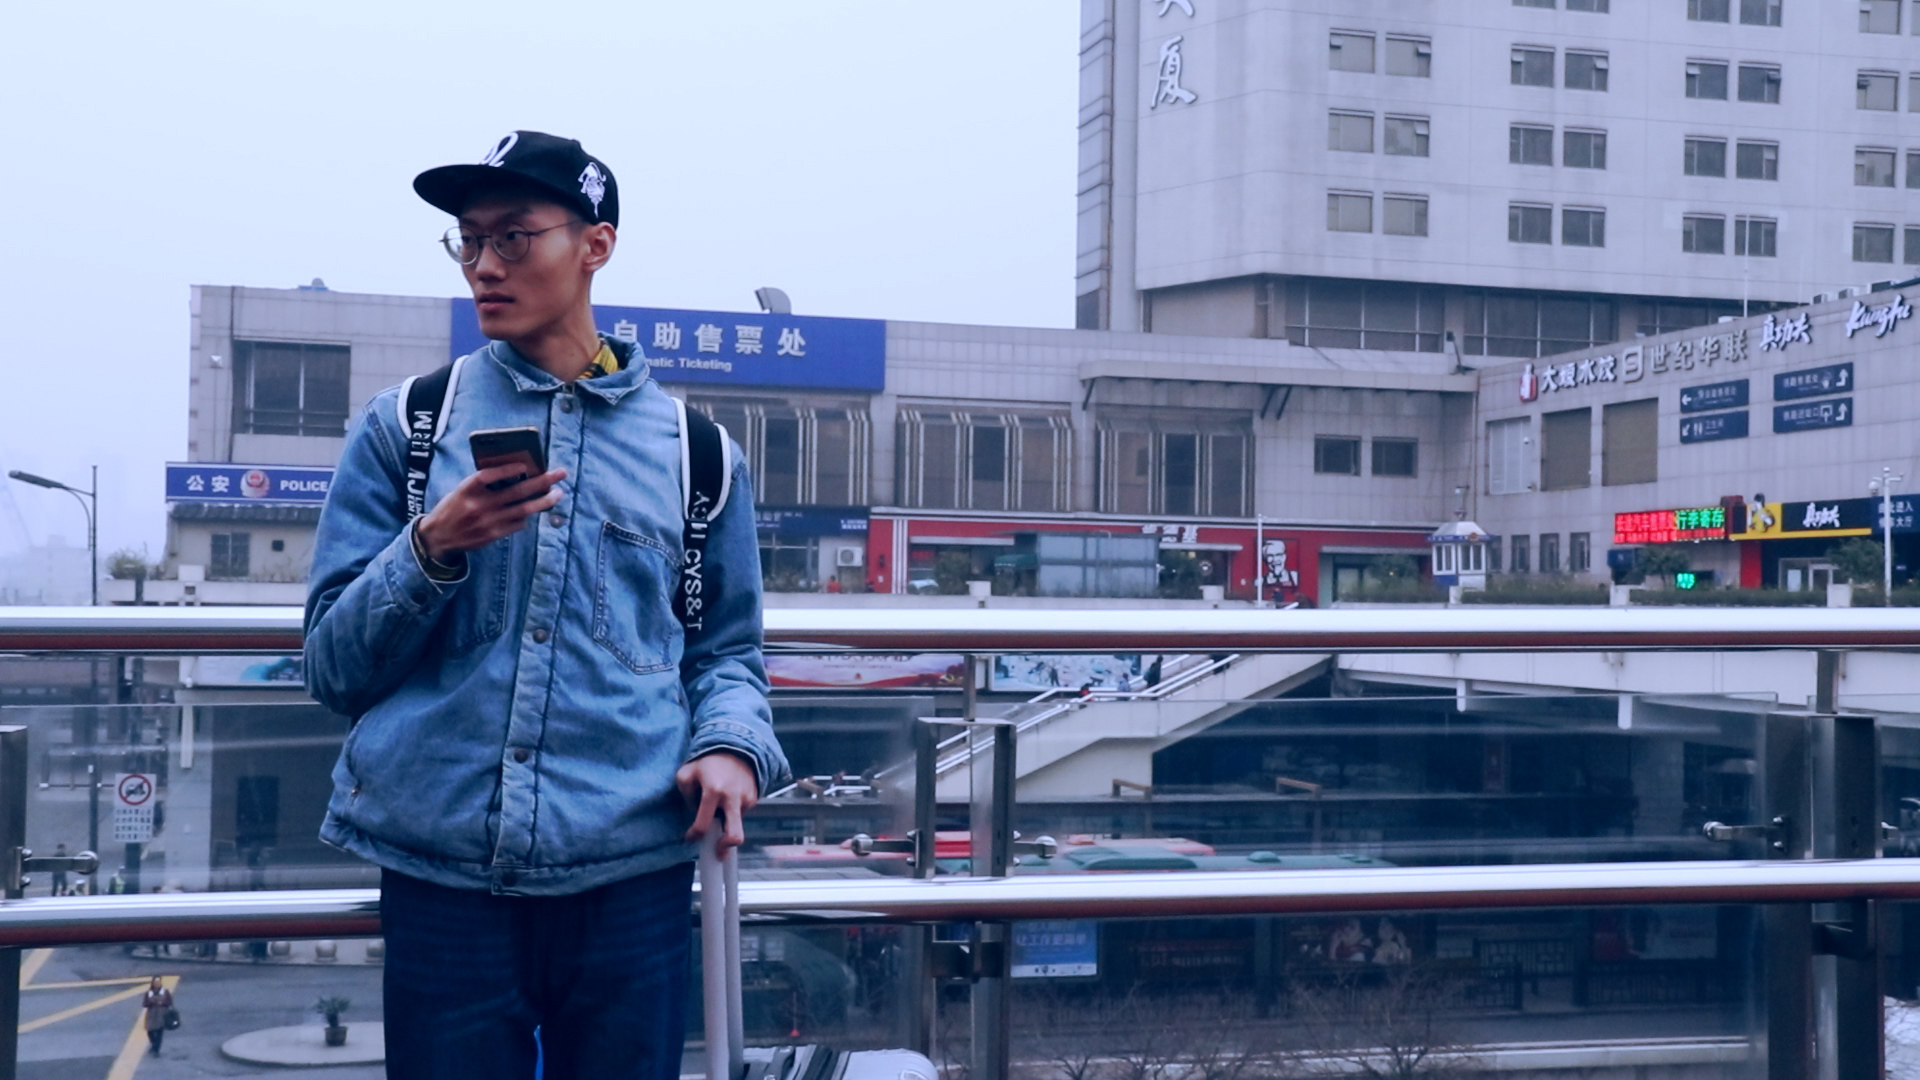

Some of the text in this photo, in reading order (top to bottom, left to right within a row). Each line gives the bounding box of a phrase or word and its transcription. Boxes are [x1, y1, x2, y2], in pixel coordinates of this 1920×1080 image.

[613, 318, 806, 357] 自助售票处
[1759, 312, 1812, 352] 真功夫
[1650, 329, 1749, 374] 世纪华联
[678, 357, 733, 373] Ticketing
[186, 475, 230, 493] 公安
[280, 480, 328, 492] POLICE
[1679, 509, 1724, 530] 行李寄存
